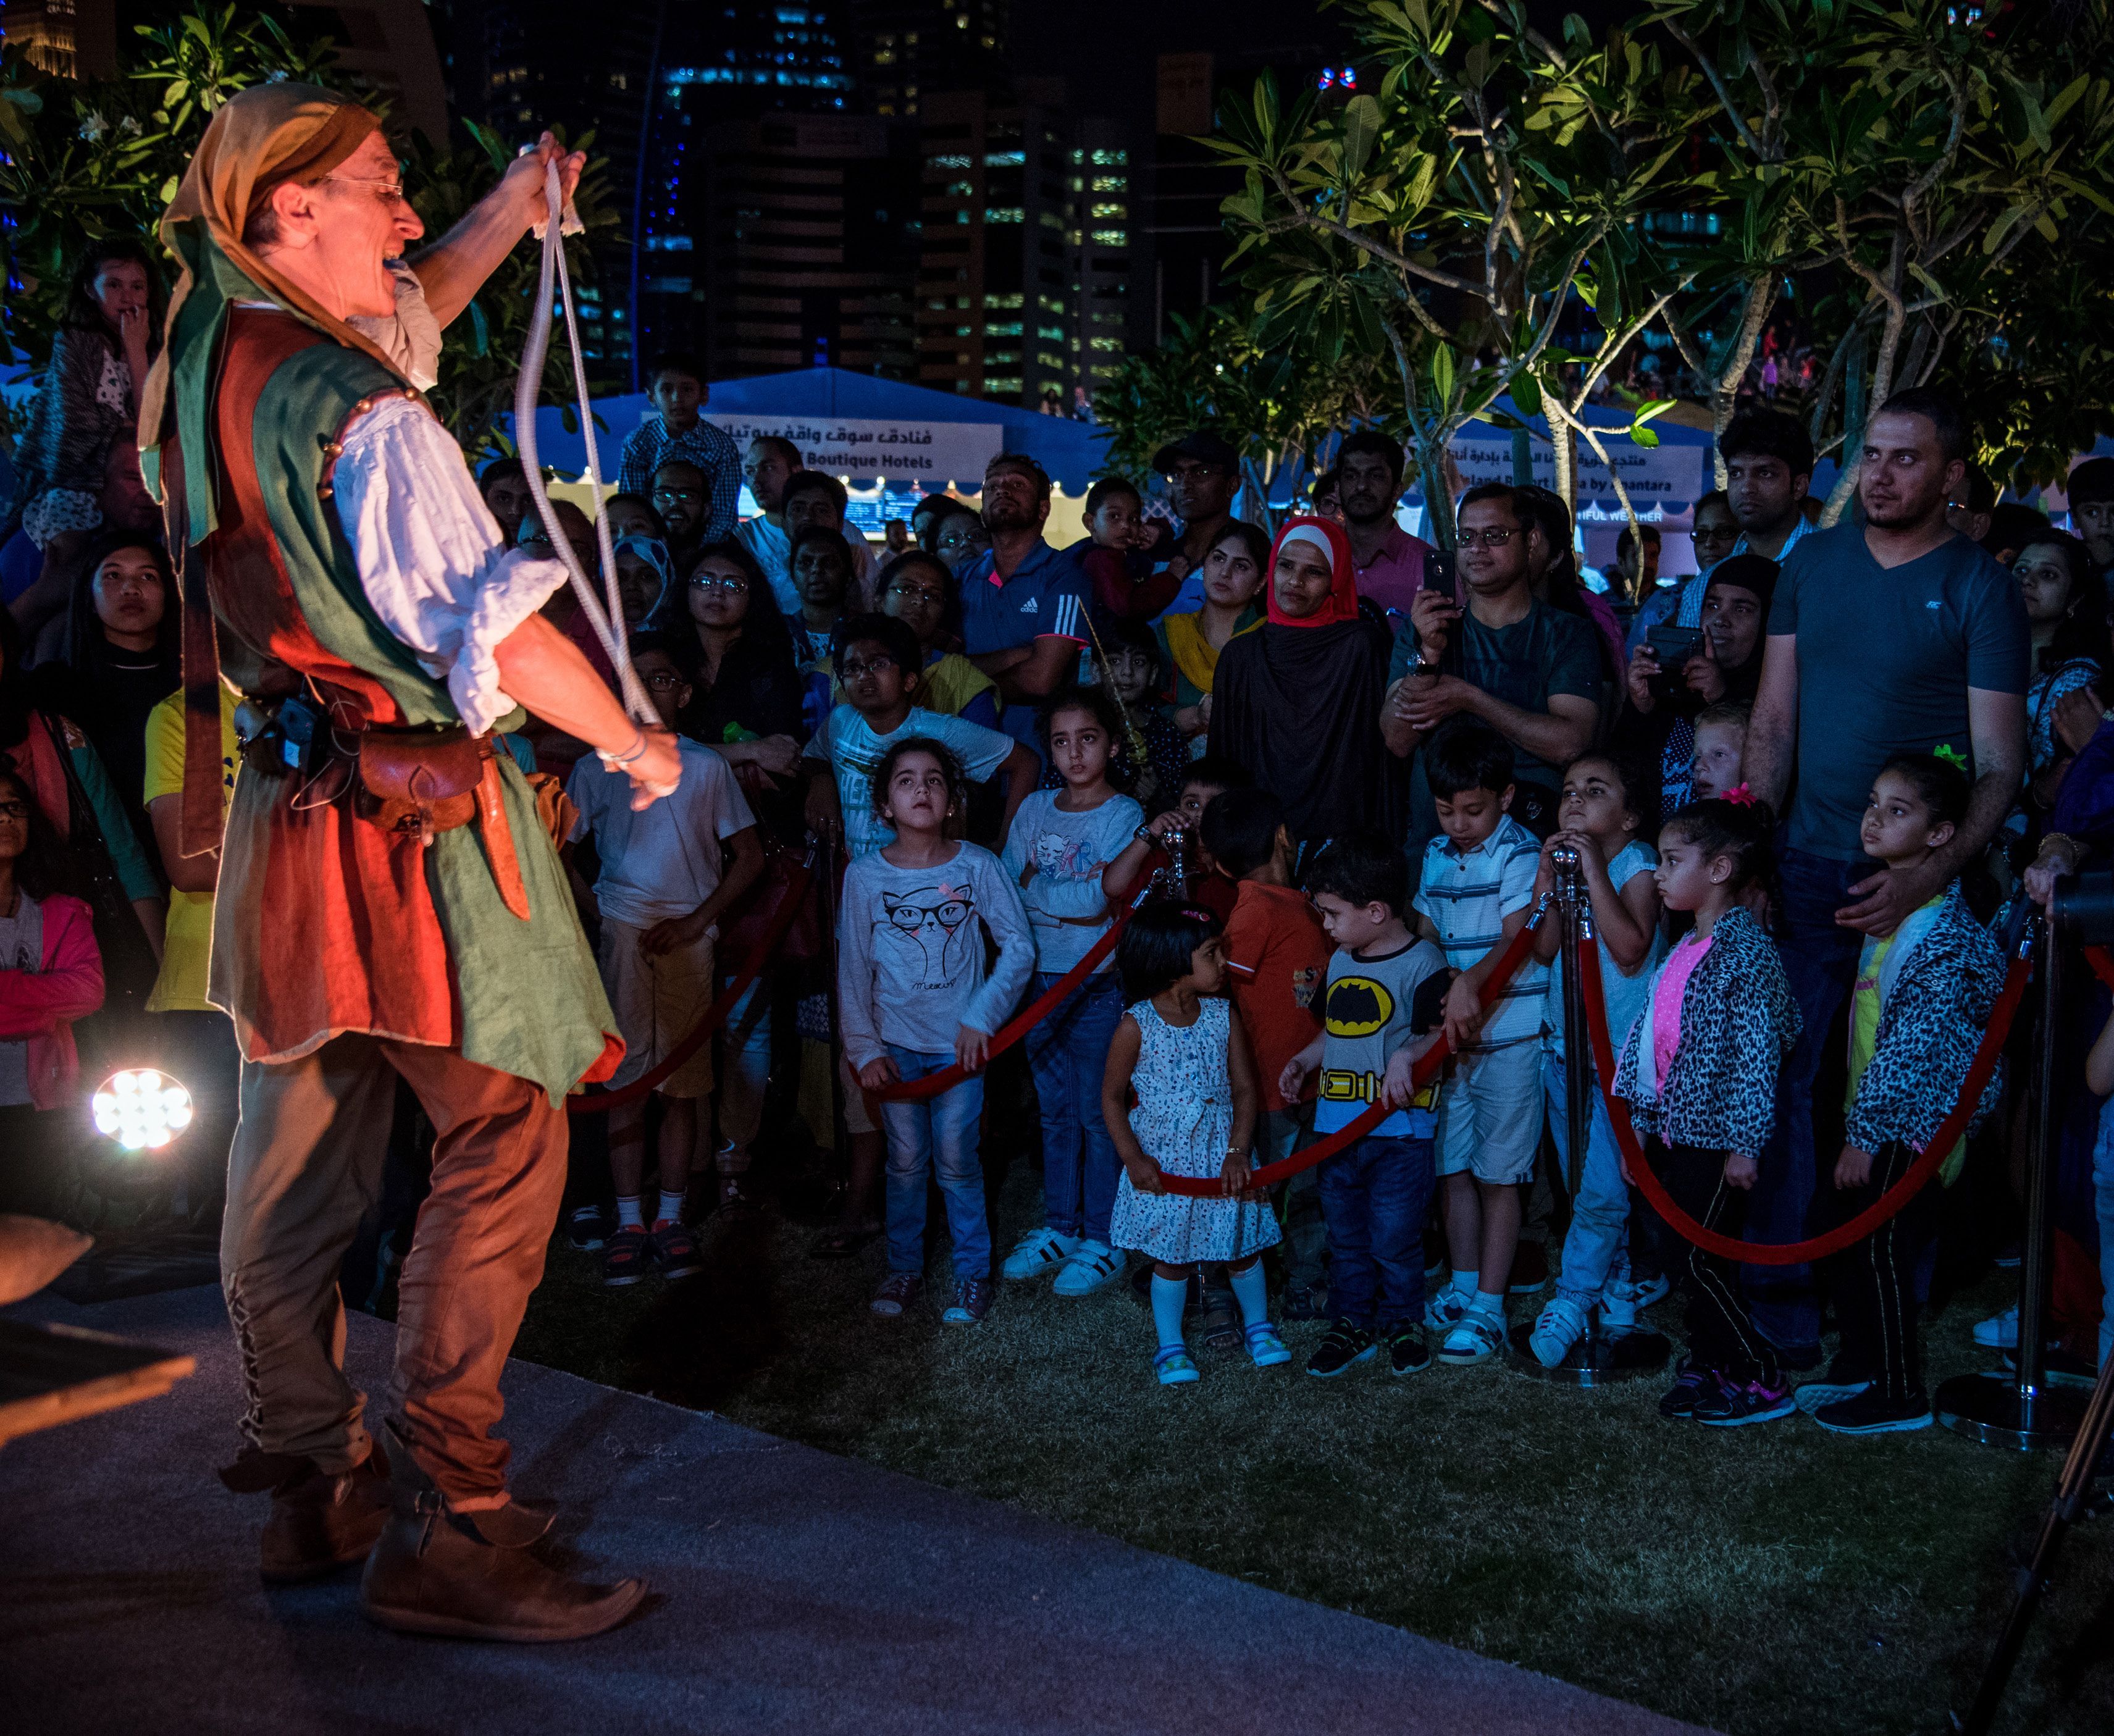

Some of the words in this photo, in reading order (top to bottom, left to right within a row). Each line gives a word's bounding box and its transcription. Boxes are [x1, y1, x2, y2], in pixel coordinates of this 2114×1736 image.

[807, 452, 877, 469] Boutique
[882, 455, 933, 469] Hotels
[1591, 478, 1607, 492] by
[1610, 480, 1671, 492] nantara
[1609, 512, 1663, 522] WEHER
